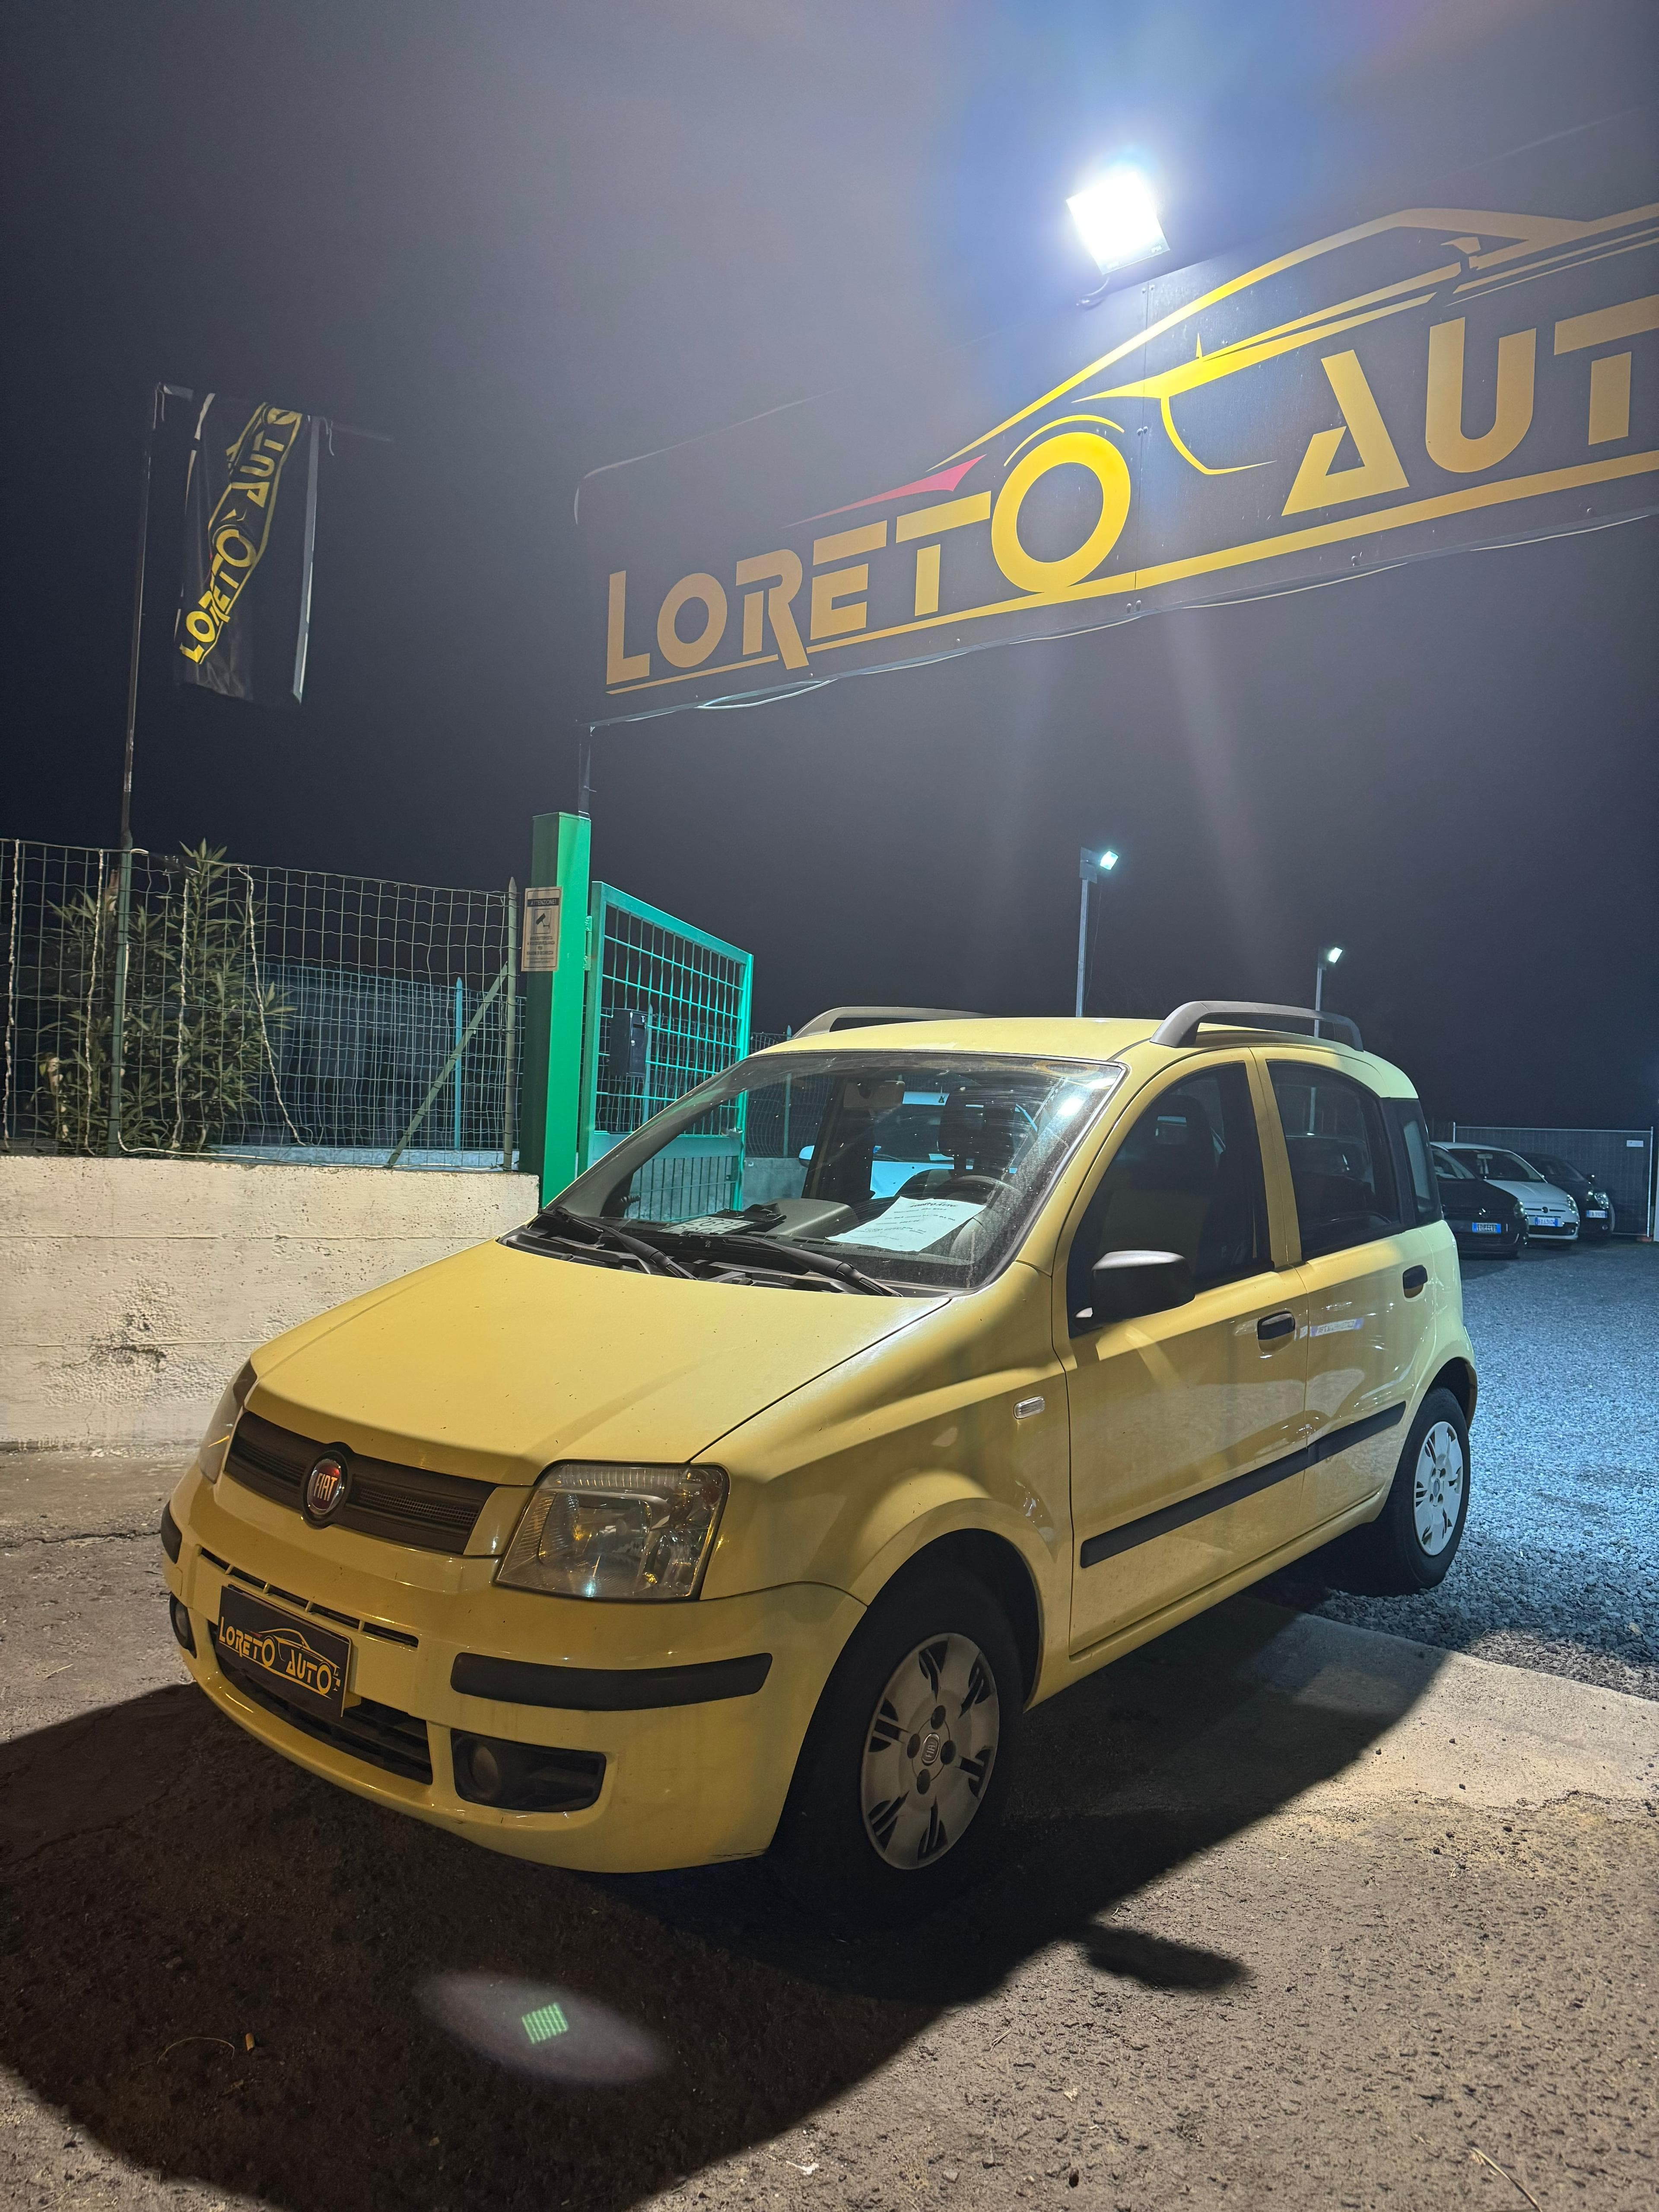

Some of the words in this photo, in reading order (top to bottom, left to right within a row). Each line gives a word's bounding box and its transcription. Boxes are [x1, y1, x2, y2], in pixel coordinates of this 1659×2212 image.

[179, 529, 257, 663] LORETO
[606, 432, 1131, 685] LORETO
[314, 1472, 338, 1501] FIAT
[219, 1616, 275, 1667] LORETO
[286, 1649, 331, 1695] AUTO
